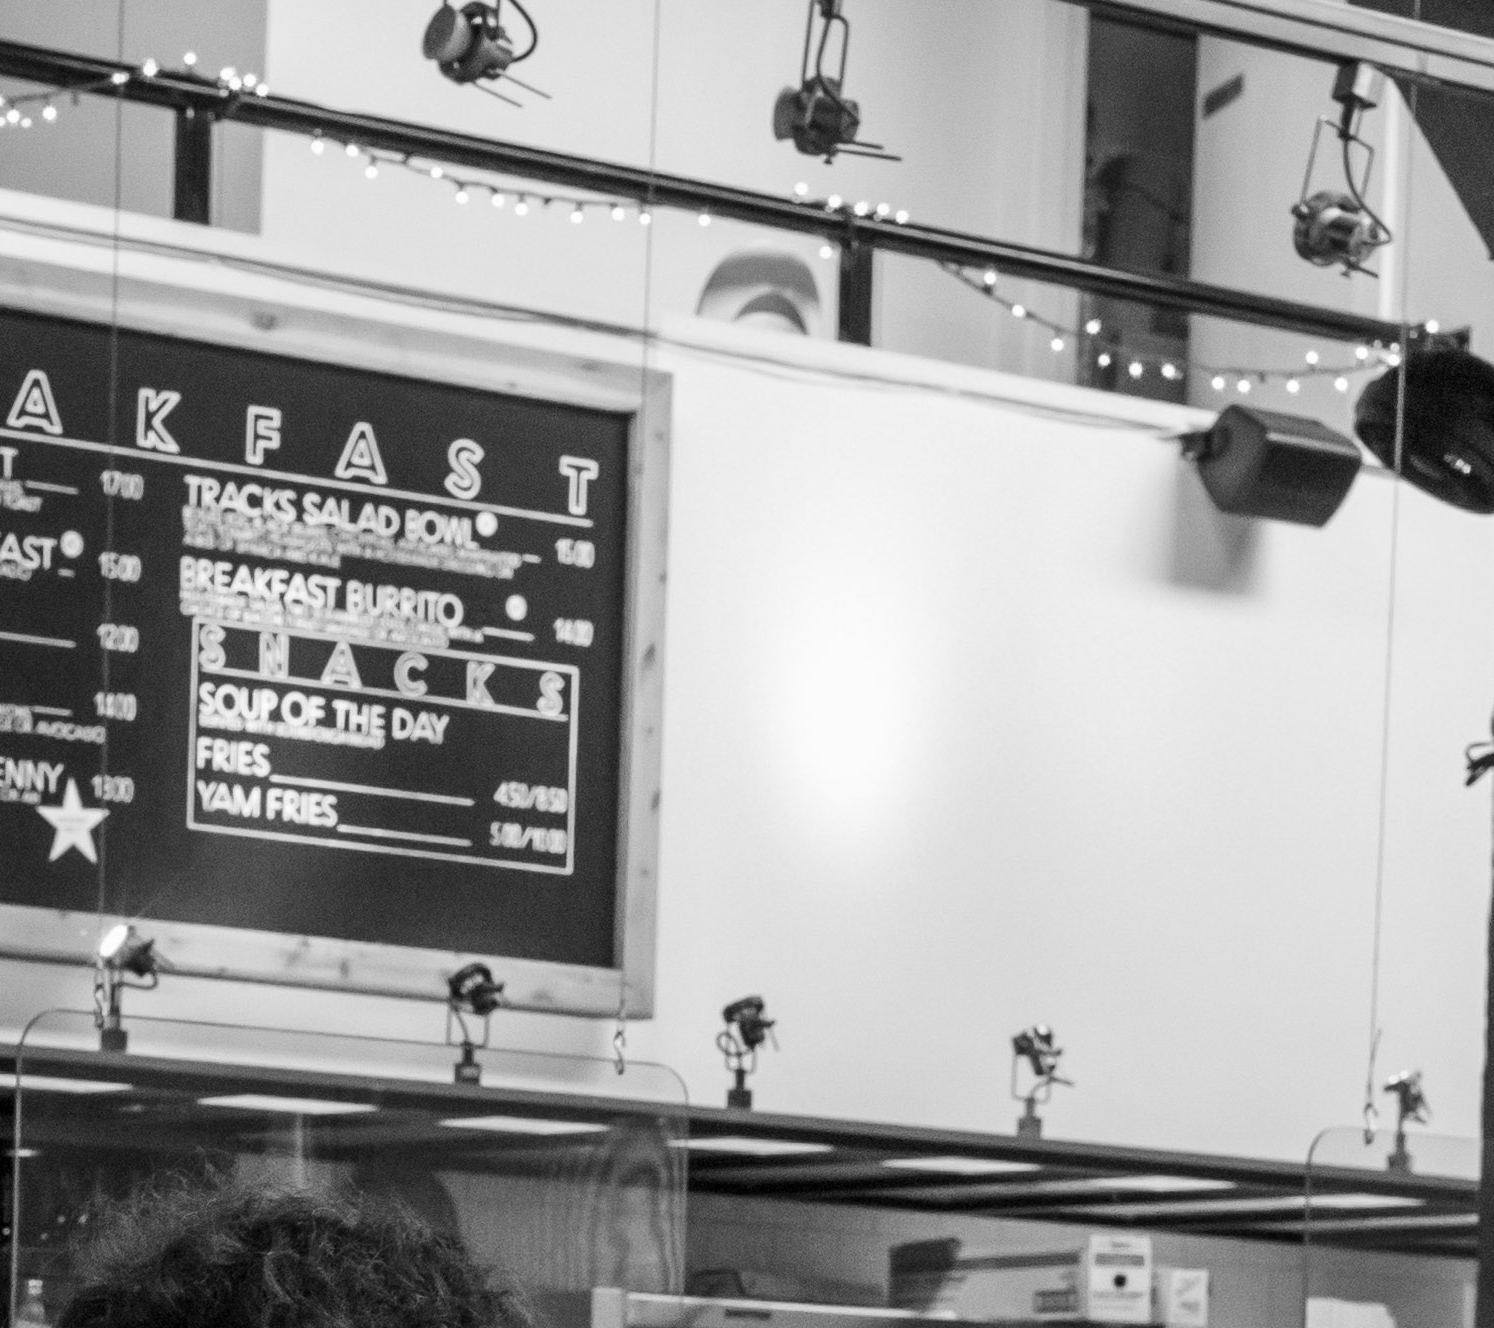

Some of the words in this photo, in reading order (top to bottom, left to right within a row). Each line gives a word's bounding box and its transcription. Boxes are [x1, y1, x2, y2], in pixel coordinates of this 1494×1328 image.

[184, 474, 296, 524] TRACKS
[303, 493, 400, 536] SALAD
[406, 509, 480, 550] BOWL
[180, 555, 341, 608] BREAKFAST
[347, 580, 464, 628] BURRITO
[199, 623, 565, 716] SNACKS
[199, 682, 279, 721] SOUP
[281, 691, 326, 728] OF
[332, 699, 386, 737] THE
[392, 707, 450, 744] DAY
[196, 736, 270, 778] FRIES
[197, 779, 261, 818] YAM
[266, 787, 338, 828] FRIES
